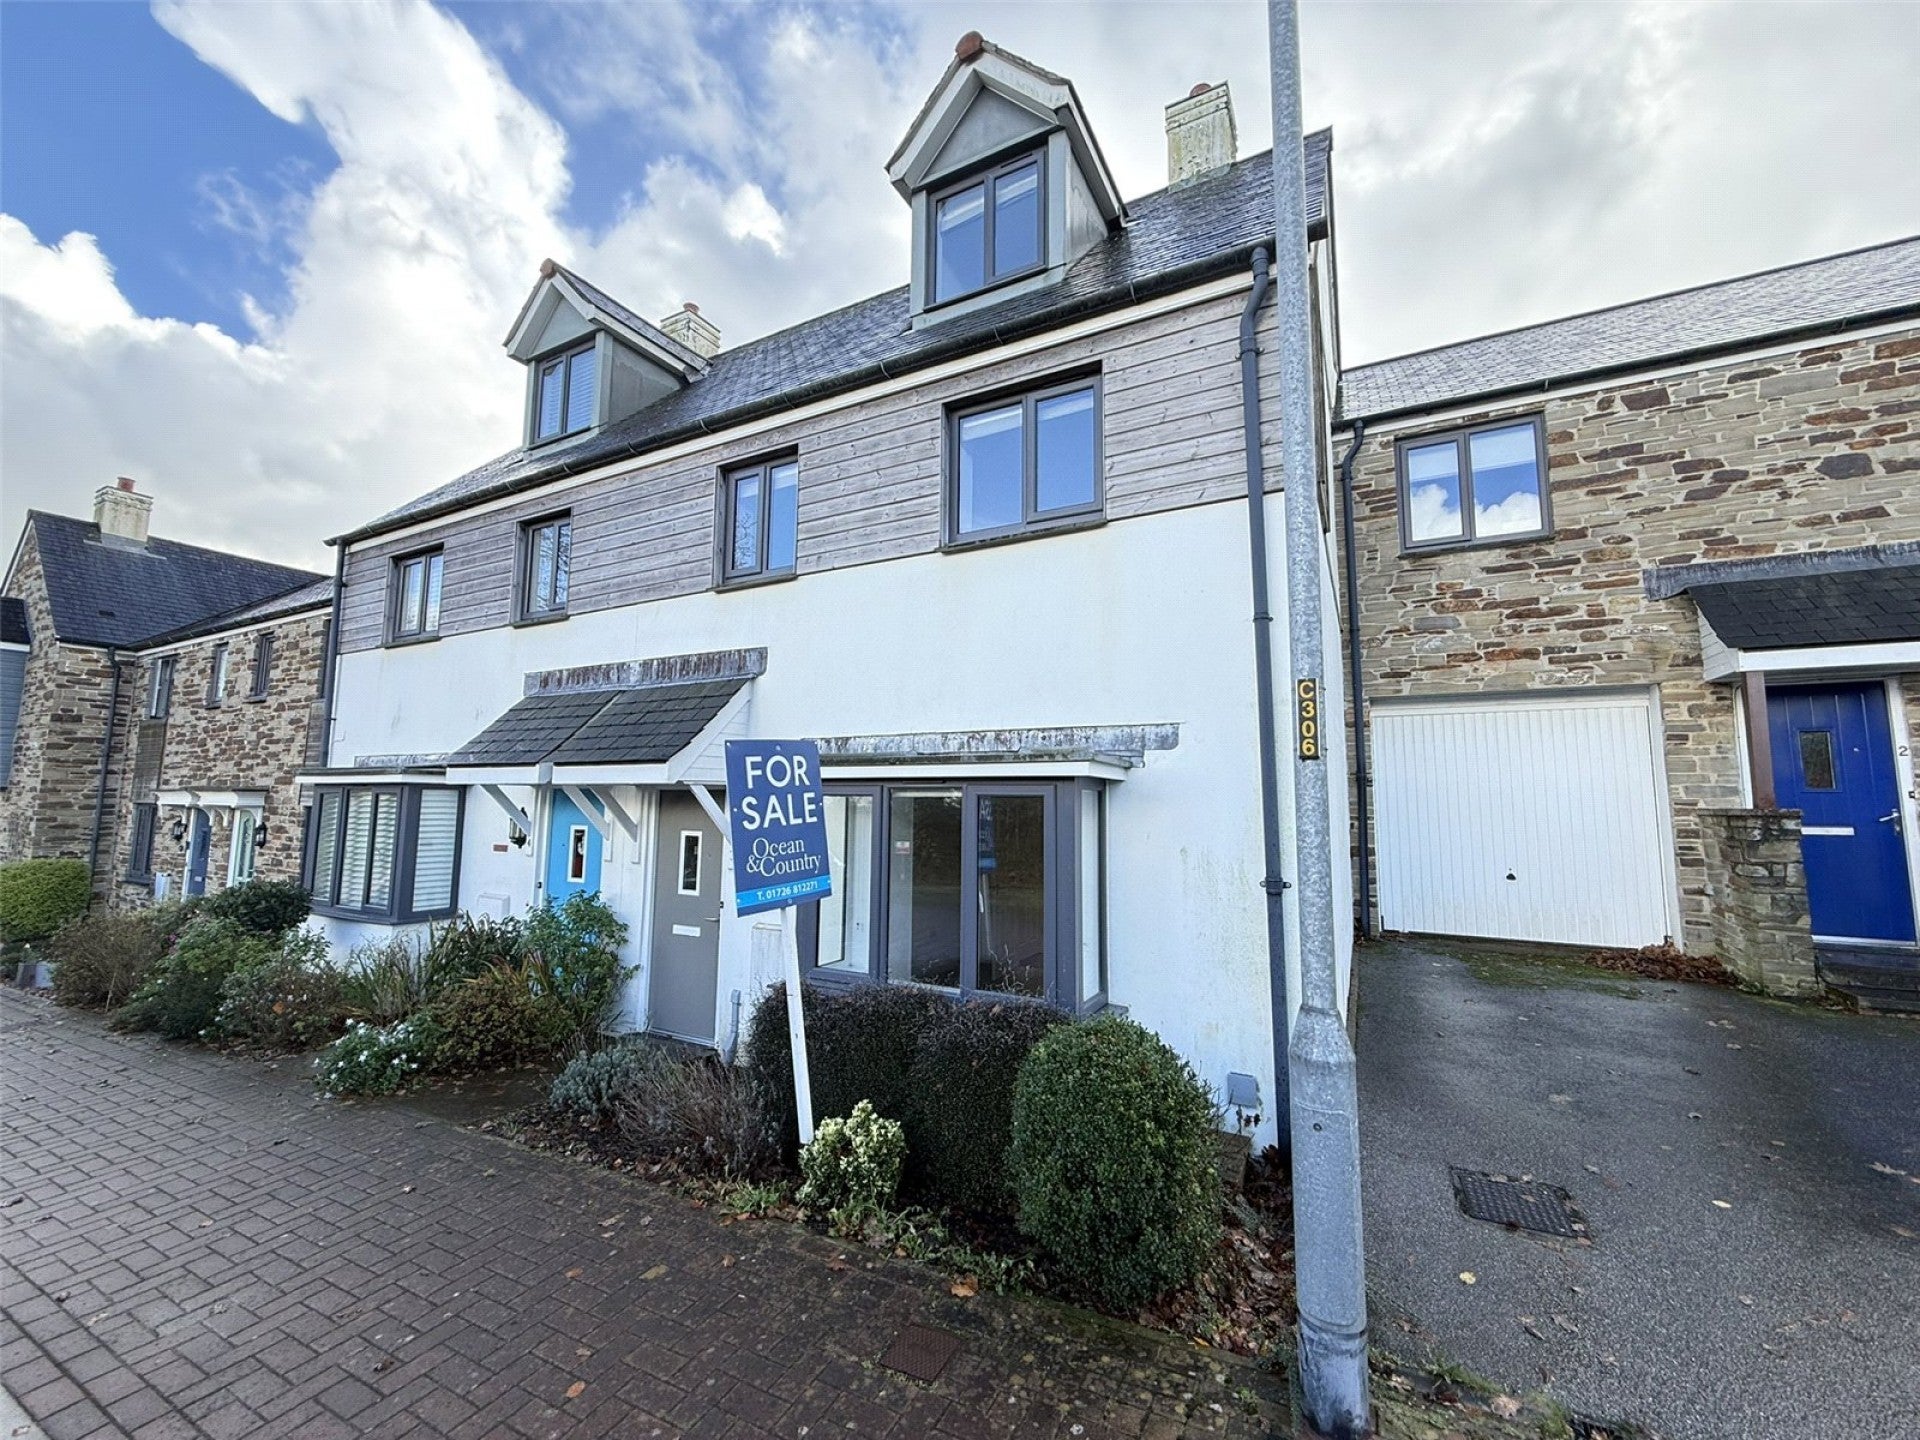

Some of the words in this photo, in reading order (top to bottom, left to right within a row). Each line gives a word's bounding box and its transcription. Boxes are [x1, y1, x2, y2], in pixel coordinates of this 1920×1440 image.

[1299, 681, 1315, 756] C306
[1898, 745, 1909, 757] 2
[745, 755, 811, 789] FOR
[741, 791, 818, 831] SALE
[752, 837, 805, 859] Ocean
[766, 886, 792, 900] 01726
[792, 881, 818, 894] 812271
